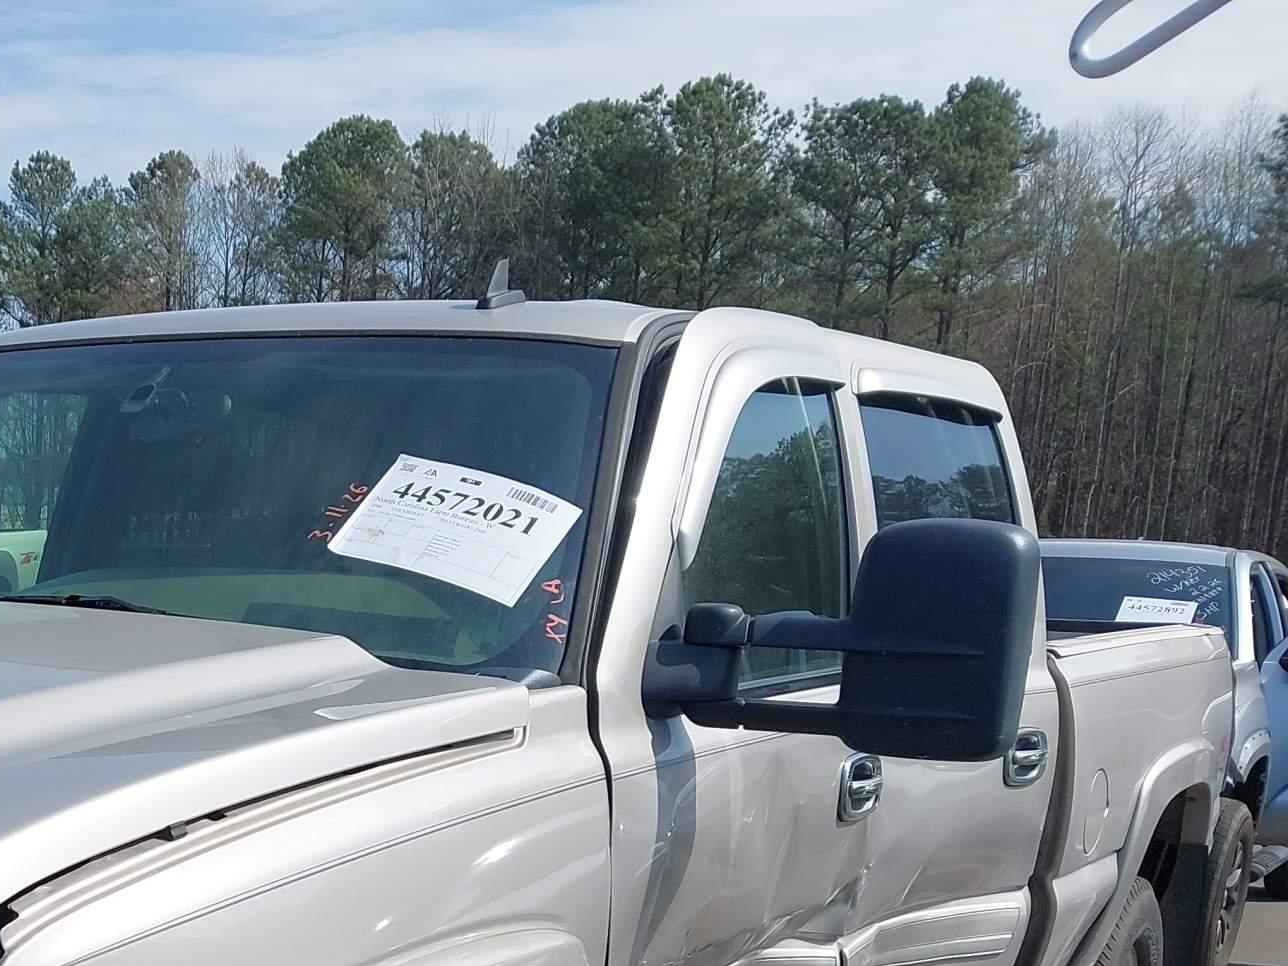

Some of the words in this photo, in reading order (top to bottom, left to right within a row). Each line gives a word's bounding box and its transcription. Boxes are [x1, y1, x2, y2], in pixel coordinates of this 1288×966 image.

[375, 496, 395, 505] North
[398, 500, 429, 512] Carolina
[393, 482, 538, 535] 44572021
[1128, 603, 1185, 615] 44572892
